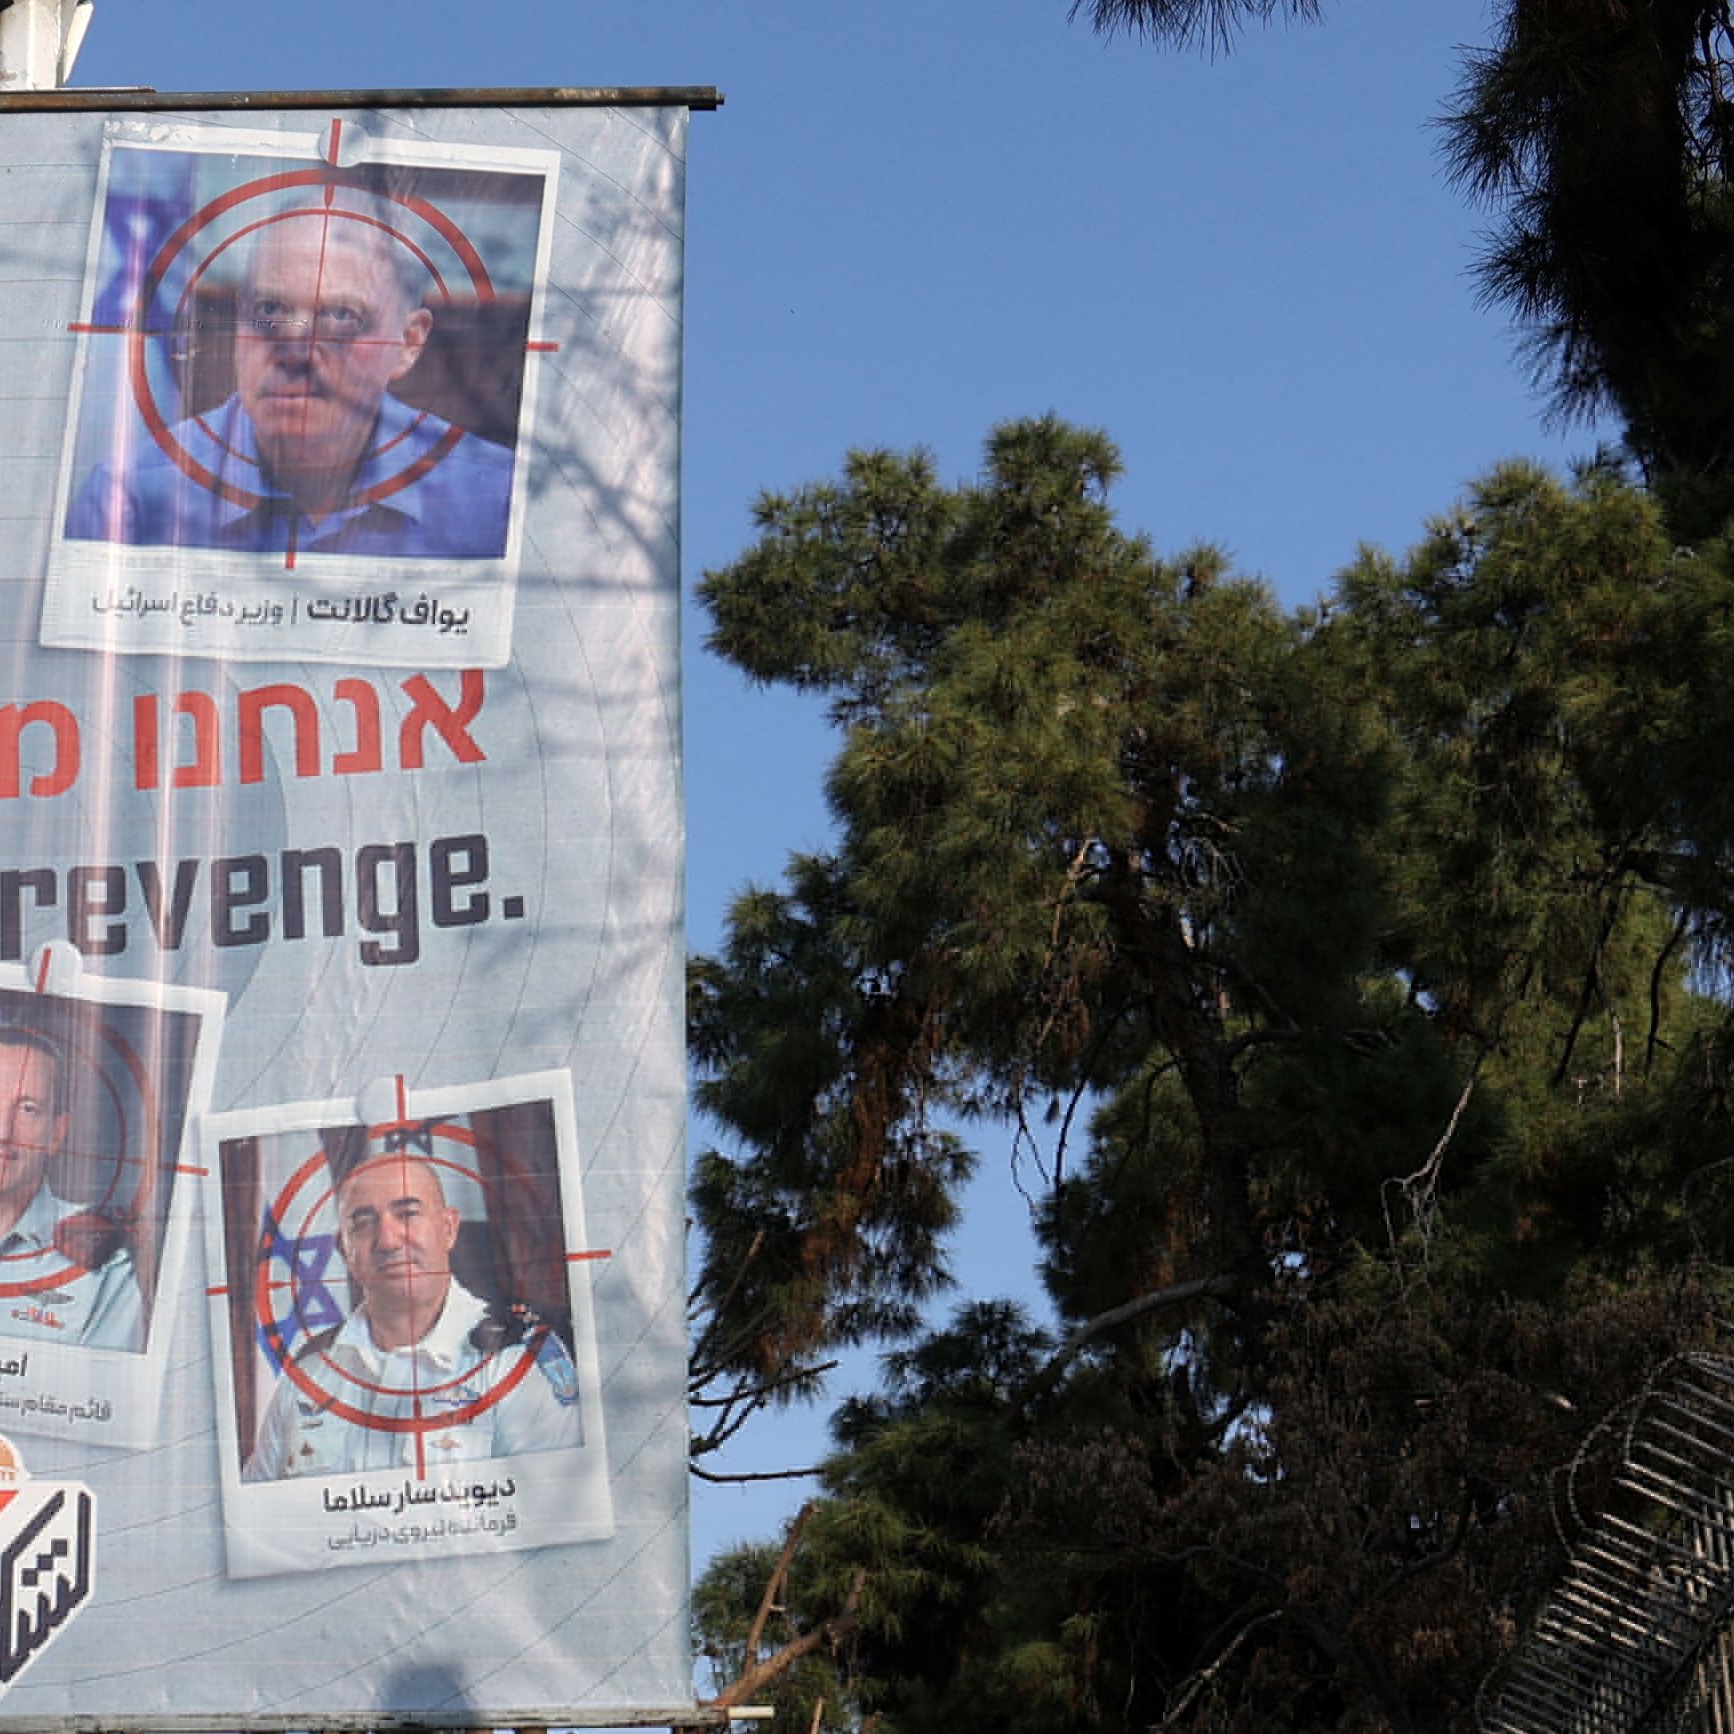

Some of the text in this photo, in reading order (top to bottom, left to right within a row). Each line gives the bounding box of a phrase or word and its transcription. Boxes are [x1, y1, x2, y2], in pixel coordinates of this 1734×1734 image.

[92, 583, 469, 634] یواف گالانت وزیر دفاع اسرائیل
[133, 668, 488, 792] אנחנו
[322, 1478, 517, 1514] دیوید سار سلاما
